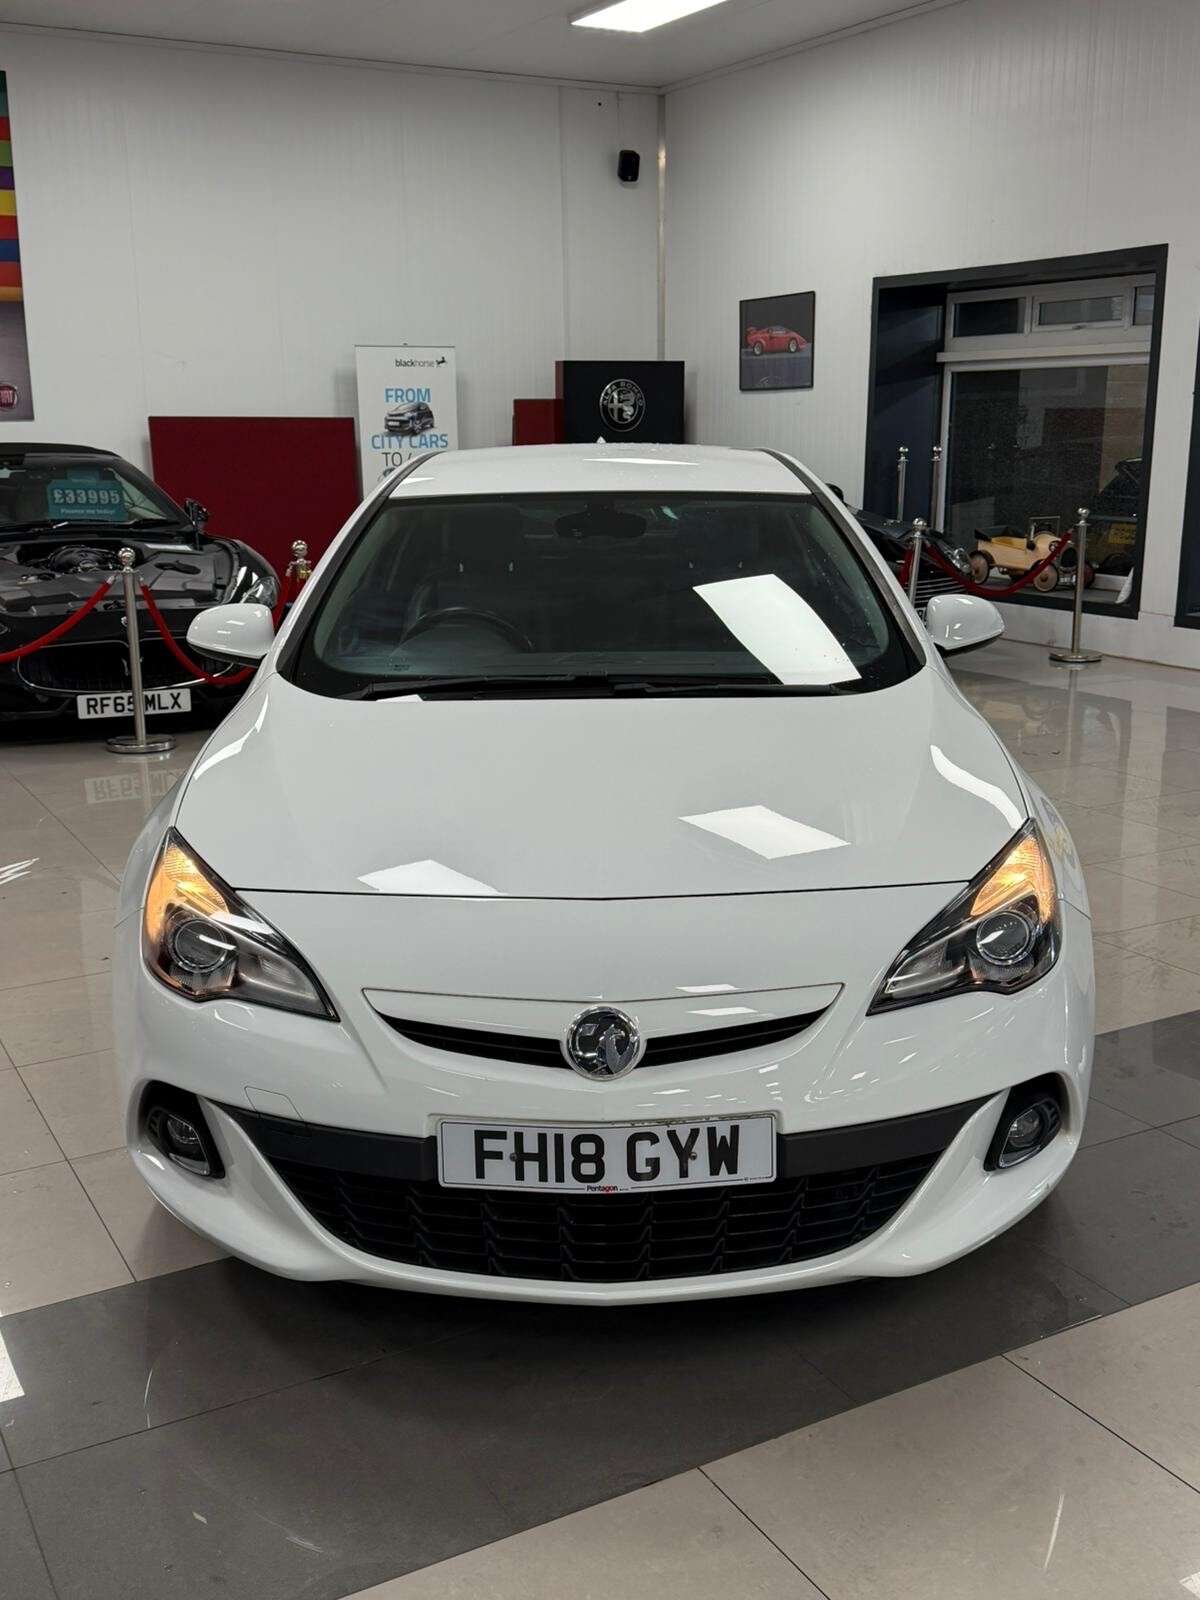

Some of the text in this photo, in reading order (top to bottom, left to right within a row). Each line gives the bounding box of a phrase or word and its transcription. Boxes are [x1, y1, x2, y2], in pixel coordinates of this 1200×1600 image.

[395, 359, 435, 368] blackhorse
[385, 388, 431, 403] FROM
[371, 433, 448, 449] CITY CARS
[382, 452, 403, 467] TO
[53, 488, 120, 504] £33995
[144, 692, 182, 712] MLX
[474, 1124, 741, 1184] FH18 GYW
